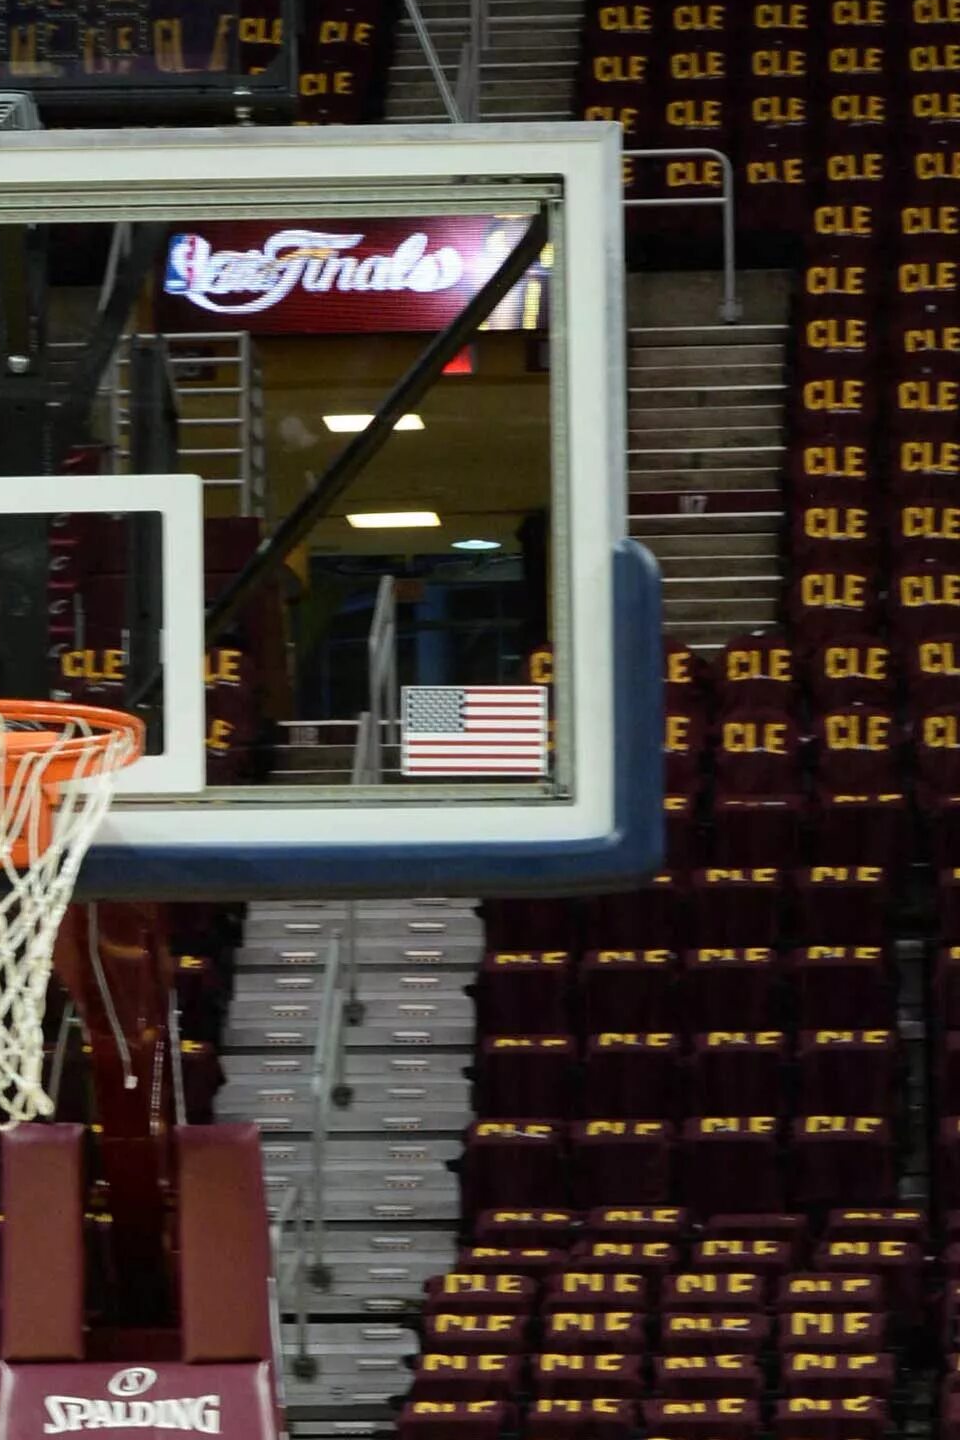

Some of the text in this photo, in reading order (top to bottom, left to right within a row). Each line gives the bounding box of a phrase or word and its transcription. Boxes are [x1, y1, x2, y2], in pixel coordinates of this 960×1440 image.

[599, 6, 651, 30] CLE
[673, 5, 724, 30] CLE
[754, 5, 806, 28] CLE
[832, 0, 884, 24] CLE
[319, 21, 373, 43] CLE
[593, 56, 647, 82] CLE
[670, 52, 723, 79] CLE
[752, 51, 804, 75] CLE
[828, 48, 881, 72] CLE
[298, 72, 352, 96] CLE
[666, 100, 722, 127] CLE
[752, 97, 803, 122] CLE
[831, 95, 886, 121] CLE
[666, 161, 722, 187] CLE
[746, 159, 802, 184] CLE
[826, 153, 883, 181] CLE
[814, 206, 872, 234] CLE
[901, 206, 960, 234] CLE
[806, 266, 866, 294] CLE
[898, 262, 958, 293] CLE
[805, 319, 867, 348] CLE
[802, 379, 866, 411] CLE
[897, 381, 960, 411] CLE
[802, 446, 867, 477] CLE
[899, 442, 960, 472] CLE
[803, 507, 869, 539] CLE
[901, 507, 960, 539] CLE
[800, 573, 866, 607] CLE
[899, 574, 960, 607] CLE
[60, 649, 128, 683] CLE
[725, 648, 794, 682] CLE
[824, 647, 890, 680] CLE
[722, 722, 787, 753] CLE
[824, 715, 891, 750] CLE
[44, 1395, 223, 1434] SPALDING
